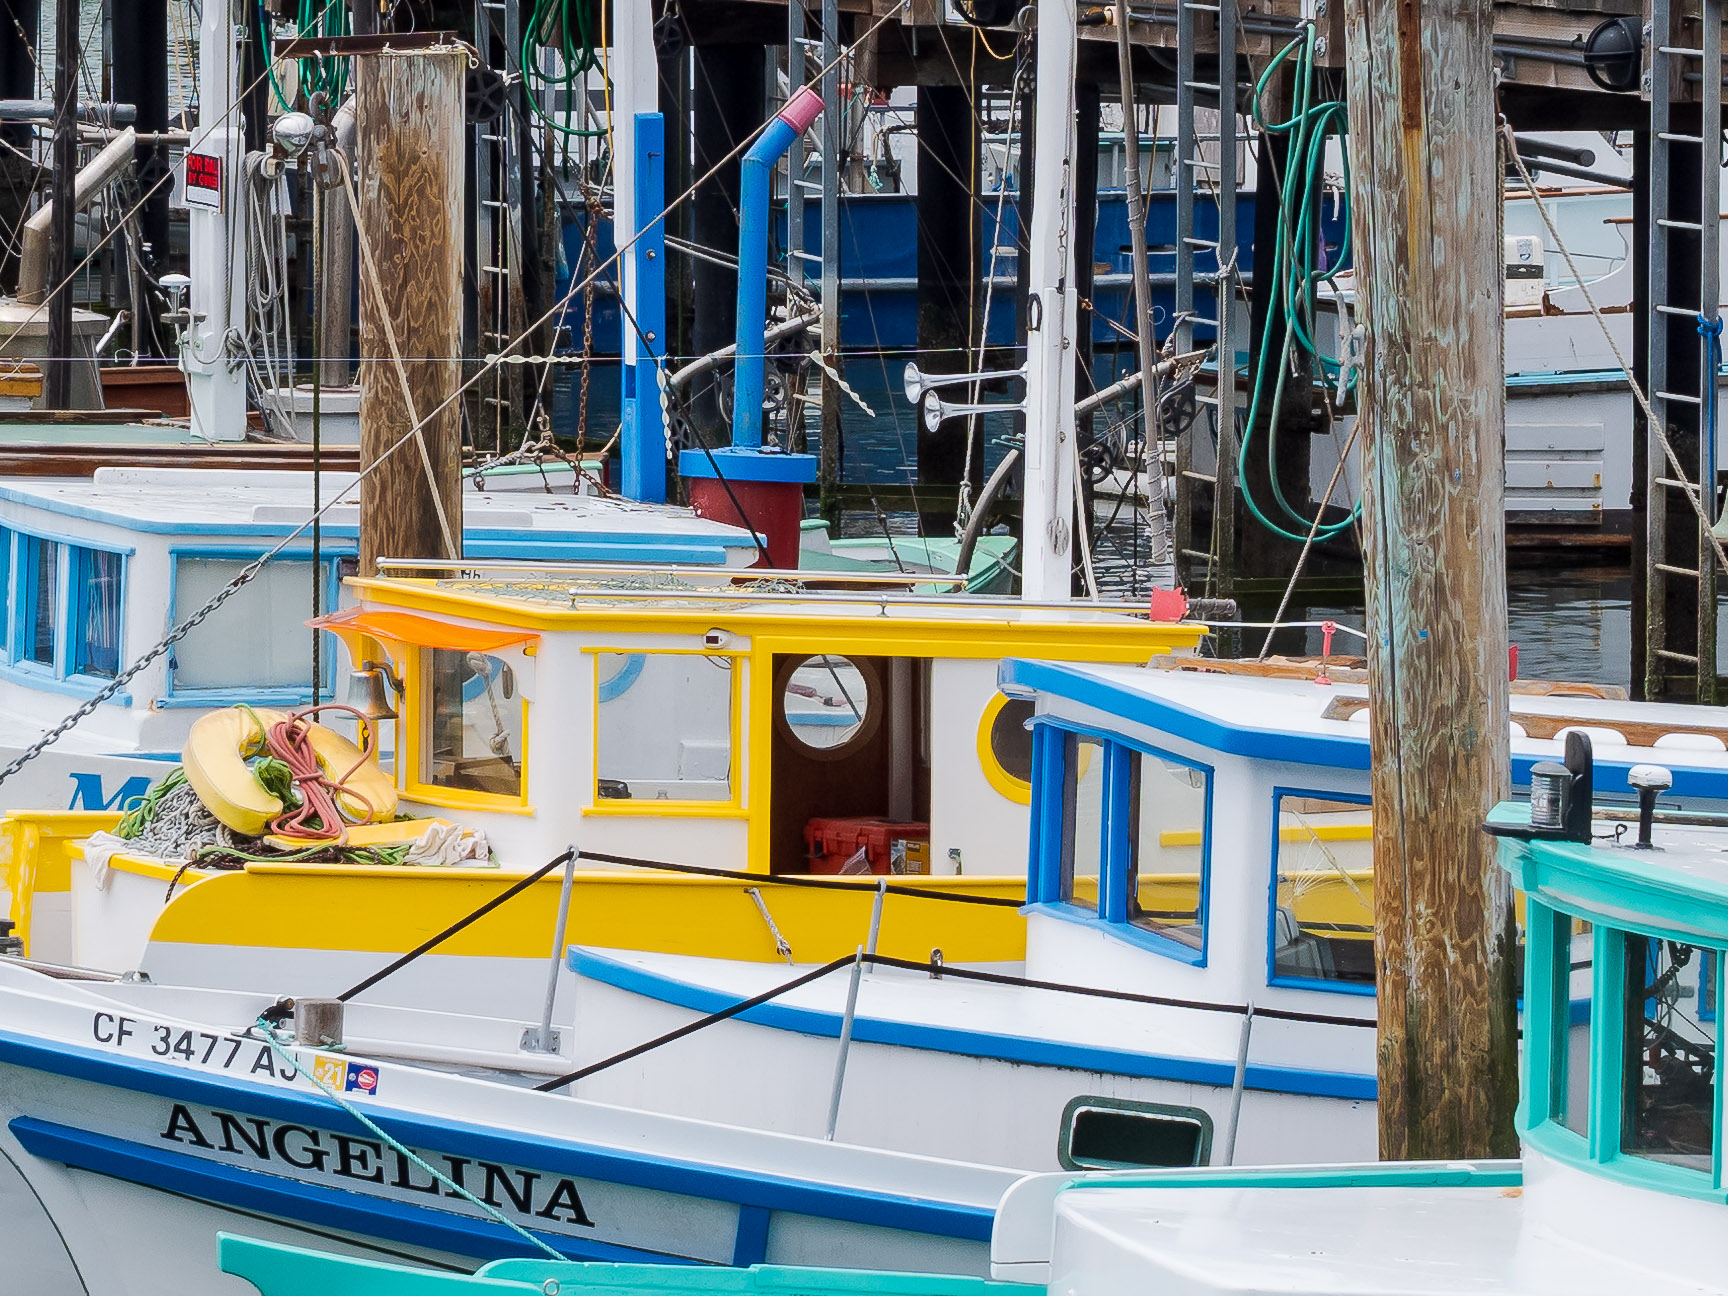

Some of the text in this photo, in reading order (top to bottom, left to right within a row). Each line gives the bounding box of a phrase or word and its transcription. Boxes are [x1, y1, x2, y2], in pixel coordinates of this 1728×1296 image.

[188, 154, 203, 172] FOR
[93, 1012, 137, 1046] CF
[151, 1024, 242, 1068] 3477
[160, 1103, 595, 1228] ANGELINA
